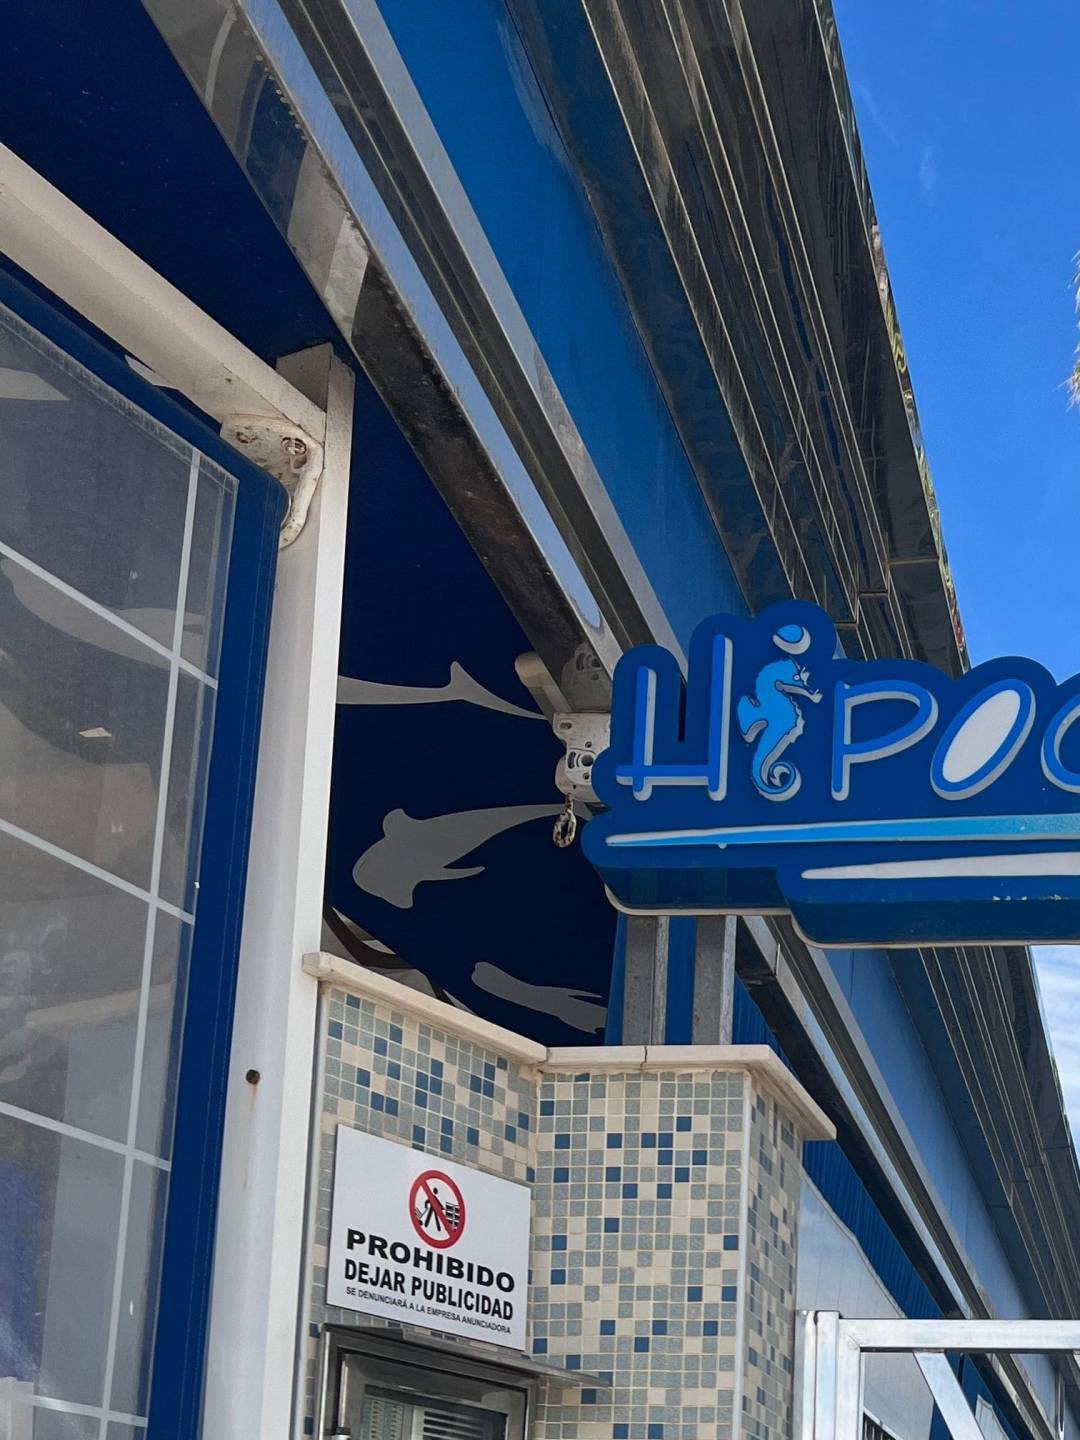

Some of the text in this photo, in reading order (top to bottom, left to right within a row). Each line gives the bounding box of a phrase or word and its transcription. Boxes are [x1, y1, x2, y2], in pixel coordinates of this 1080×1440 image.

[344, 1258, 513, 1321] DEJAR PUBLICIDAD
[347, 1228, 515, 1293] PROHIBIDO
[346, 1286, 511, 1334] SE DENUNCIARÁ A LA EMPRESA ANUNCIADORA
